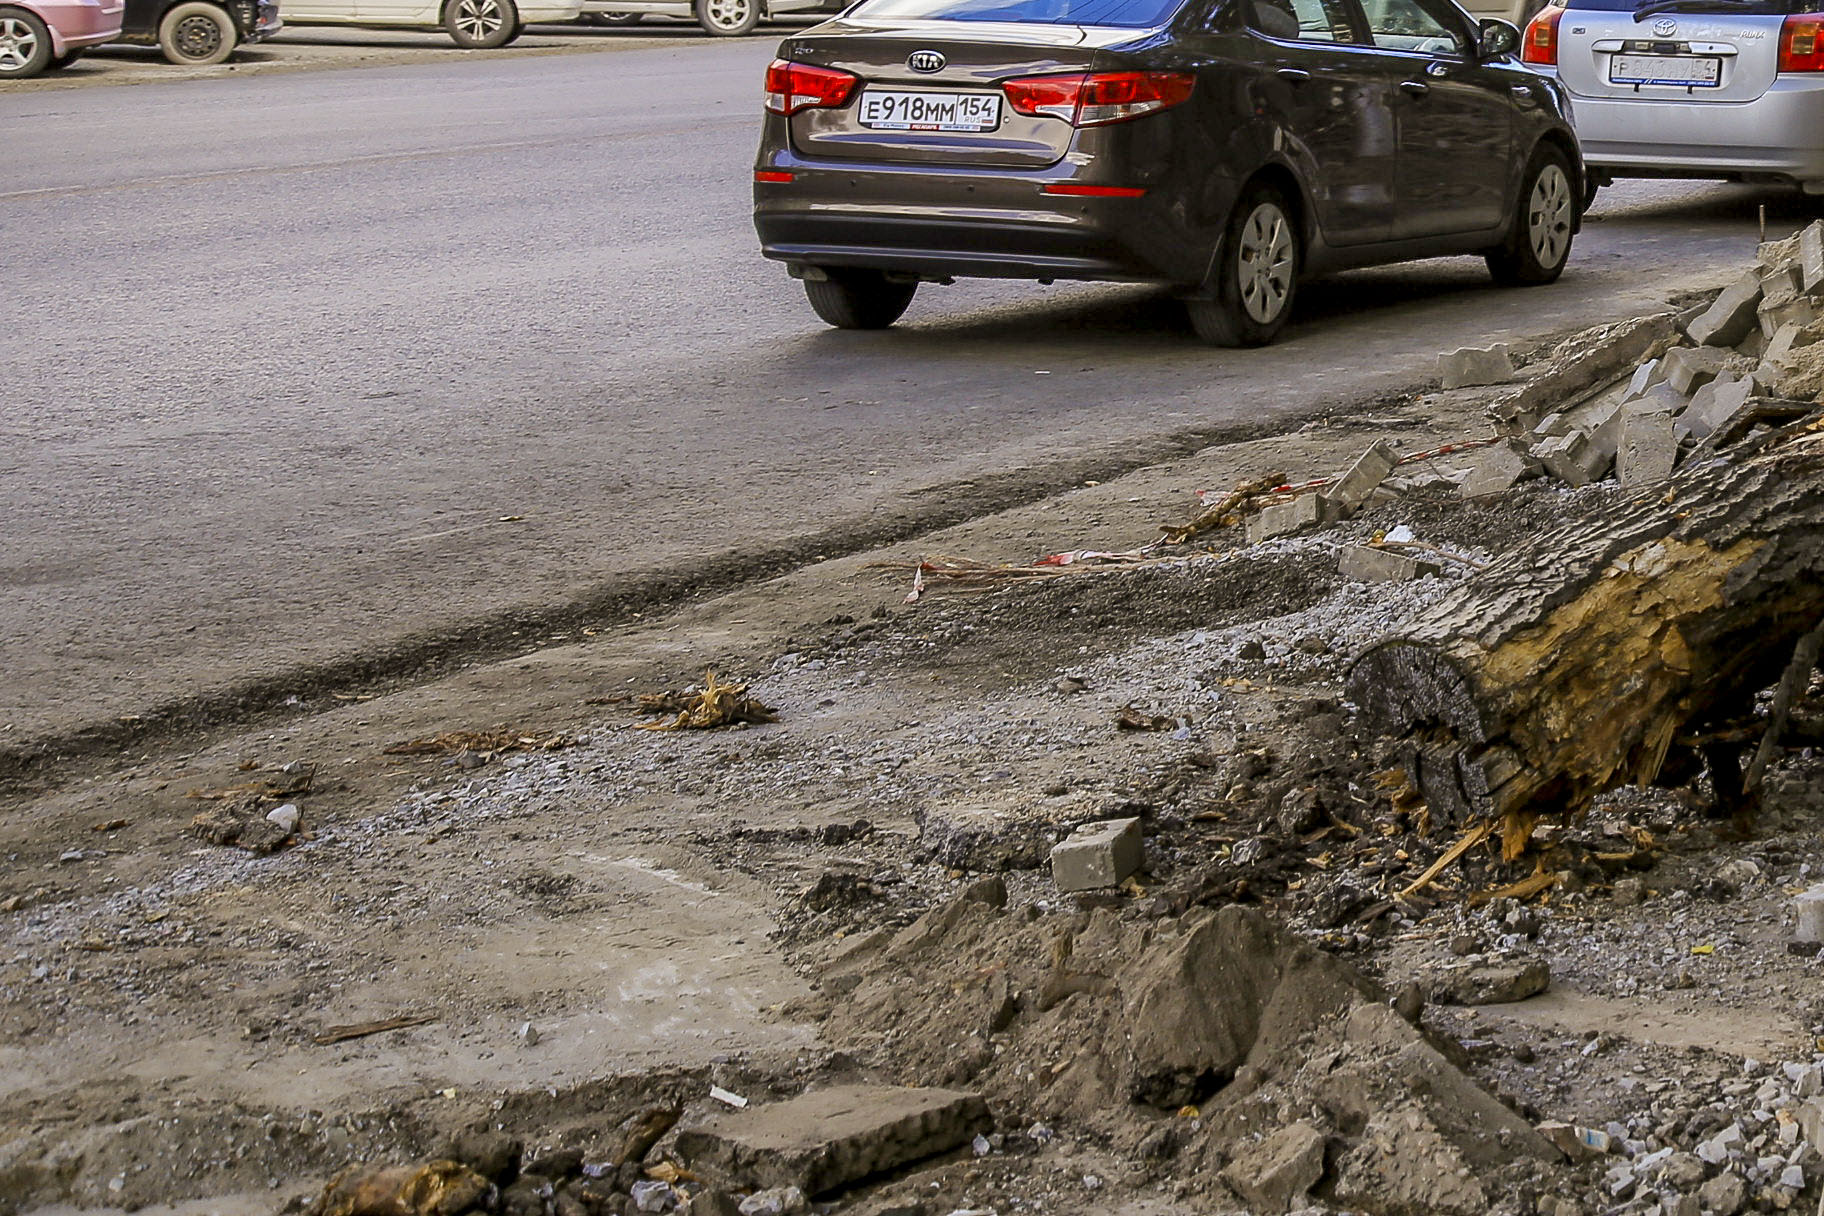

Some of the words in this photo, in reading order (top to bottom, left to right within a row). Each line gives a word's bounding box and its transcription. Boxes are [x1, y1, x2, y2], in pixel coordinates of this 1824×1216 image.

[912, 54, 941, 69] KIA
[866, 96, 956, 125] Е918ММ
[959, 97, 993, 119] 154
[964, 116, 981, 124] RUS
